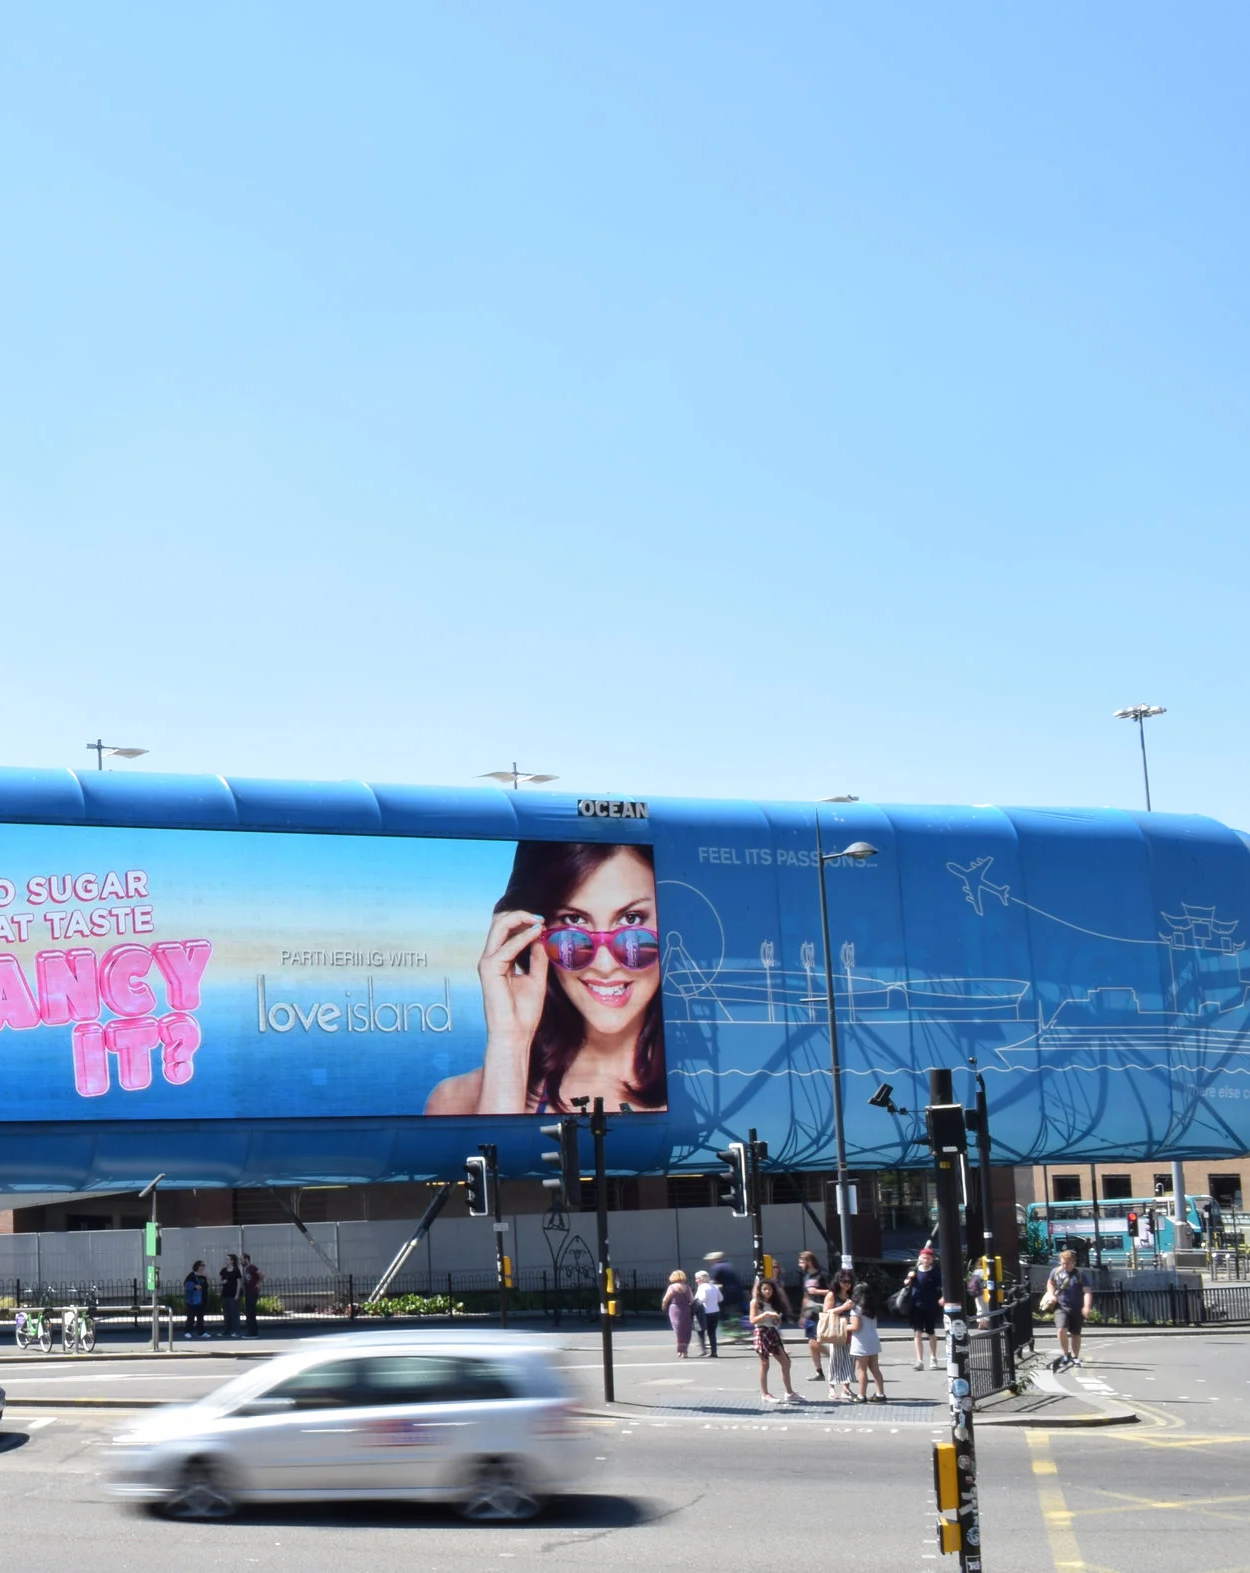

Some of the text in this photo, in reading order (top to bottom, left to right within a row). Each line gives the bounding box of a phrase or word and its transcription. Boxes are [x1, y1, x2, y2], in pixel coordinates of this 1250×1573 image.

[579, 799, 649, 818] OCEAN
[698, 847, 741, 865] FEEL
[745, 849, 772, 865] ITS
[26, 870, 150, 906] SUGAR
[43, 904, 154, 940] TASTE
[281, 950, 428, 968] PARTNERING WITH
[256, 974, 452, 1033] love island
[71, 1011, 202, 1098] IT?
[1218, 1085, 1241, 1099] else
